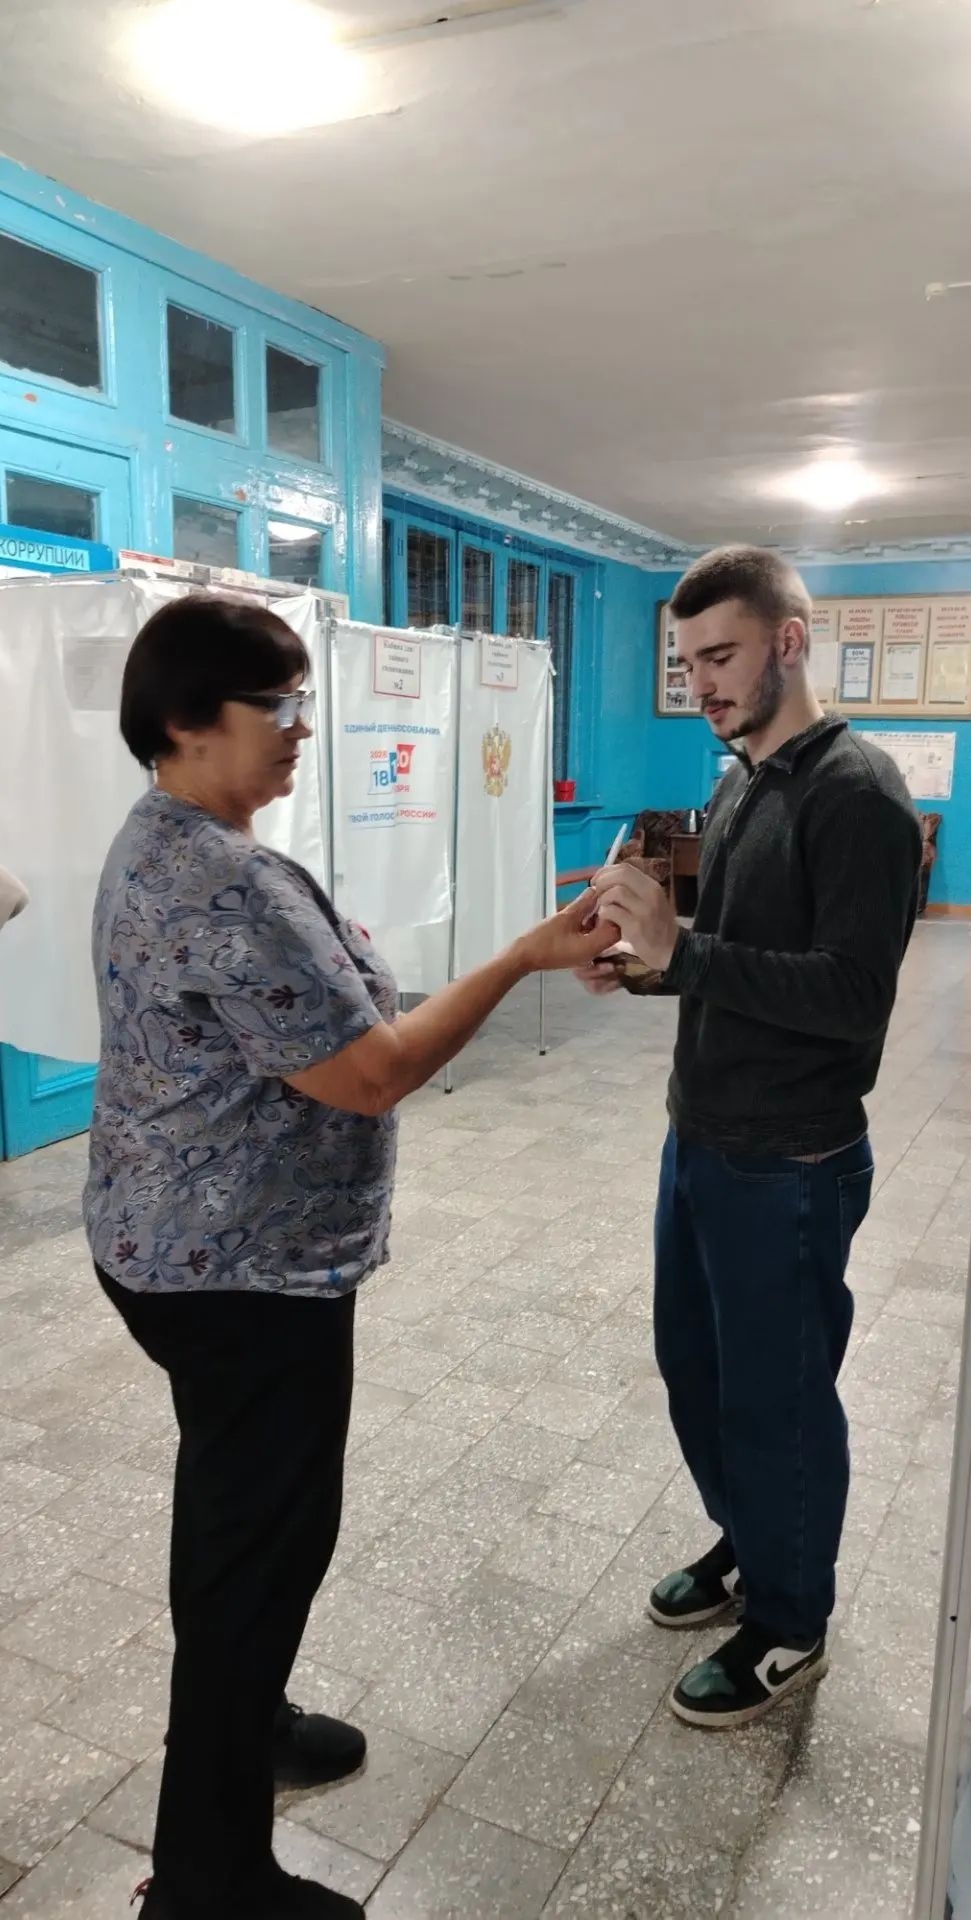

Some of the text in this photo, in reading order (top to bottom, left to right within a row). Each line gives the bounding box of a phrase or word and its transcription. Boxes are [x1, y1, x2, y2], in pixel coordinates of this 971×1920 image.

[0, 538, 85, 568] КОРРУПЦИИ
[344, 722, 377, 734] ЕДИНЫЙ
[372, 769, 389, 787] 18
[370, 811, 395, 822] ГОЛОС
